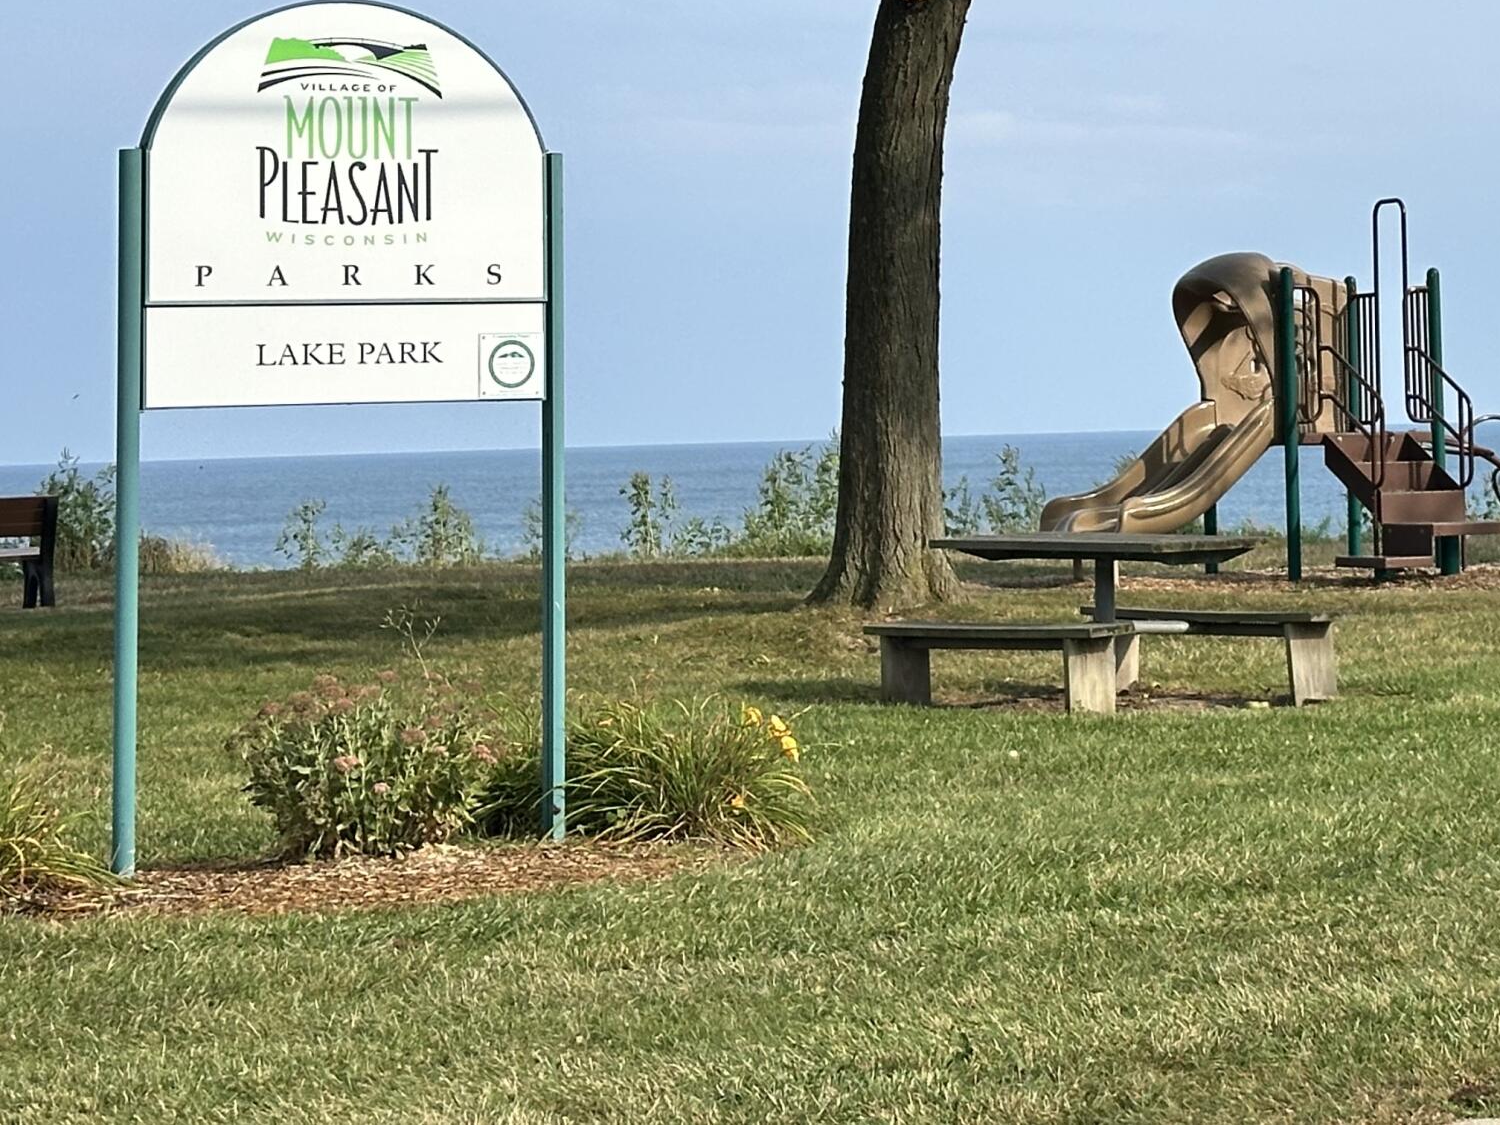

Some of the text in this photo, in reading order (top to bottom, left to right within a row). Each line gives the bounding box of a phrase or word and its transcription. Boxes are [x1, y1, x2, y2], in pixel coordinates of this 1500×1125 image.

[300, 83, 398, 93] VILLAGE OF
[283, 95, 419, 160] MOUNT
[255, 146, 439, 226] PLEASANT
[265, 231, 429, 246] WISCONSIN
[194, 263, 502, 287] PARKS
[256, 341, 443, 366] LAKE PARK
